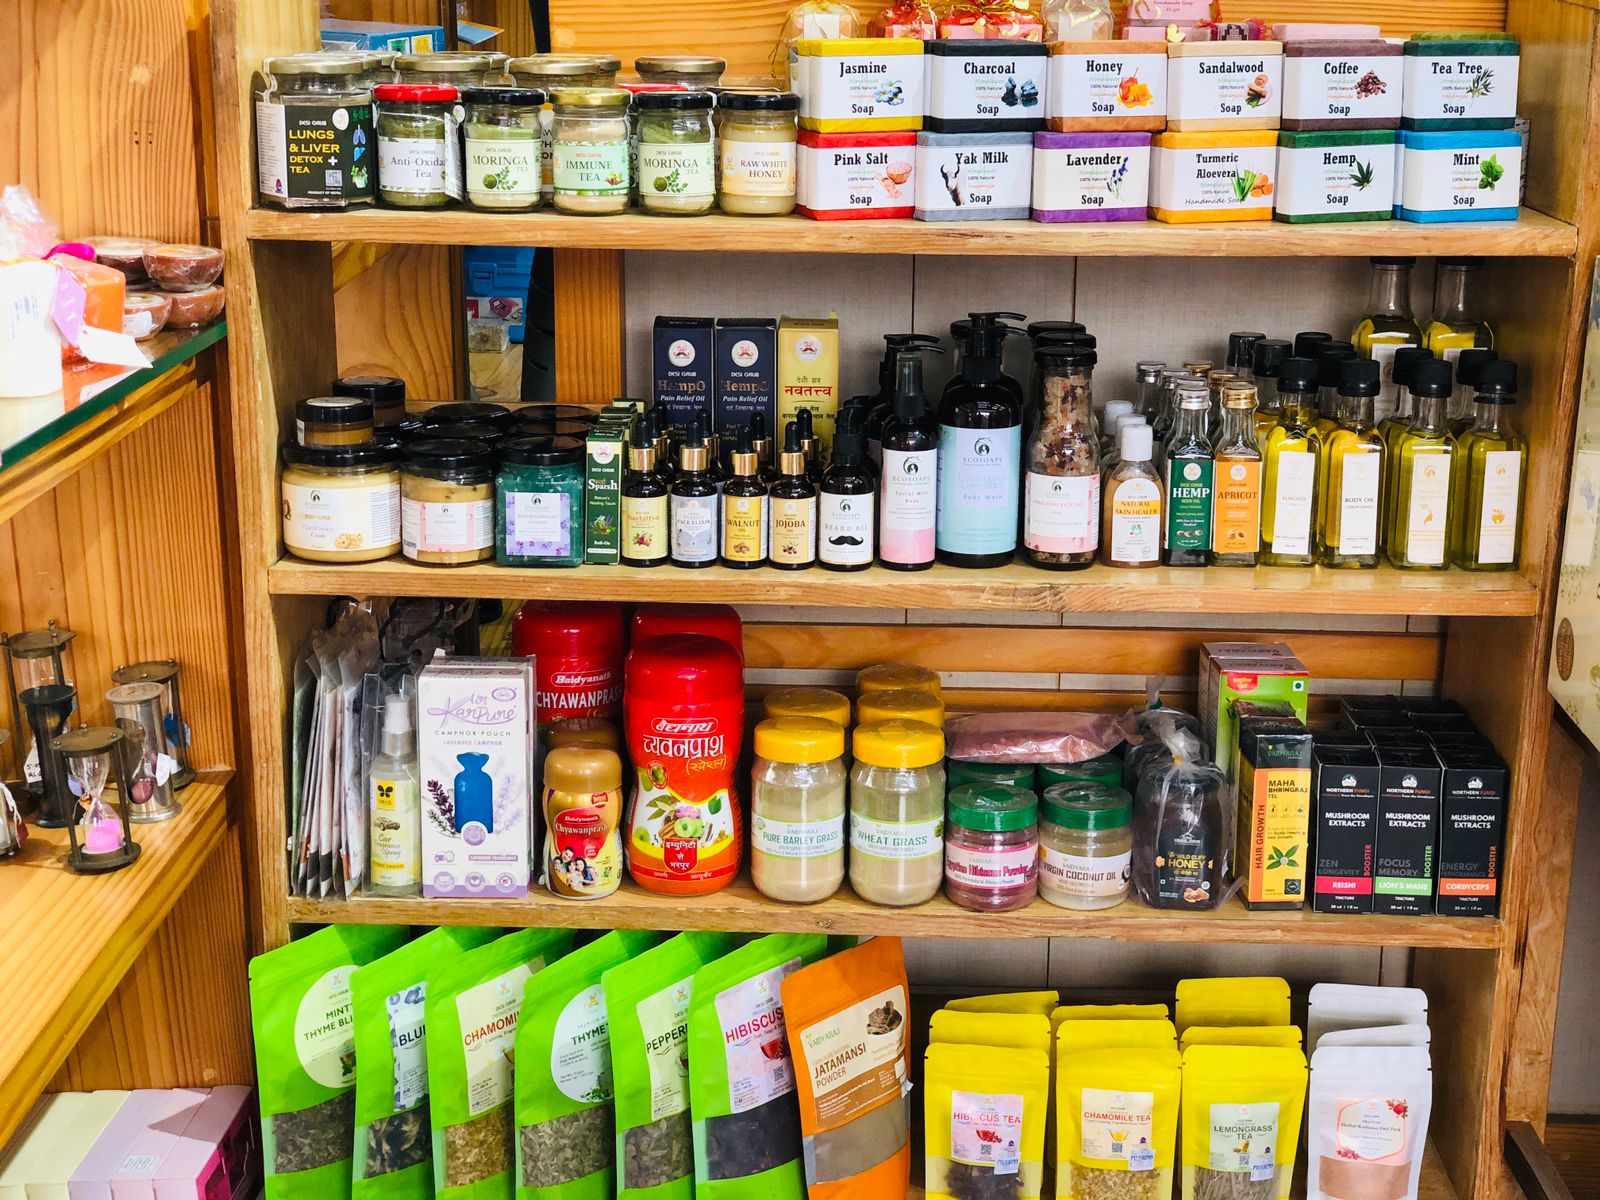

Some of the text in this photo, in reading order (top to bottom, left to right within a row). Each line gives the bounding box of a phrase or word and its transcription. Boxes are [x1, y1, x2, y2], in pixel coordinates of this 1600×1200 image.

[839, 61, 888, 77] Jasmine
[963, 61, 1015, 74] Charcoal
[1086, 60, 1123, 74] Honey
[1199, 61, 1264, 74] Sandalwood
[1324, 62, 1358, 74] Coffee
[1432, 62, 1483, 74] Tea Tree
[852, 104, 875, 115] Soap
[977, 104, 999, 116] Soap
[1092, 102, 1114, 114] Soap
[1220, 103, 1242, 114] Soap
[1328, 104, 1350, 115] Soap
[1443, 104, 1465, 115] Soap
[289, 130, 334, 140] LUNGS
[289, 144, 340, 153] & LIVER
[289, 156, 324, 164] DETOX
[472, 156, 528, 166] MORINGA
[643, 158, 699, 168] MORINGA
[740, 159, 789, 168] RAW WHITE
[834, 152, 888, 166] Pink Salt
[955, 152, 1009, 165] Yak Milk
[1066, 154, 1121, 166] Lavender
[1196, 153, 1239, 164] Turmeric
[1323, 153, 1357, 167] Hemp
[1453, 153, 1480, 165] Mint
[290, 166, 310, 174] TEA
[565, 161, 611, 170] IMMUNE
[415, 169, 431, 178] Tea
[579, 172, 601, 181] TEA
[749, 169, 783, 178] HONEY
[1196, 169, 1236, 179] Aloevera
[850, 195, 872, 206] Soap
[969, 193, 992, 205] Soap
[1081, 195, 1104, 206] Soap
[1185, 197, 1226, 205] Handmade
[1326, 194, 1349, 205] Soap
[1453, 195, 1475, 206] Soap
[588, 479, 618, 491] Sparsh
[1172, 487, 1210, 498] HEMP
[727, 519, 760, 527] WALNUT
[775, 519, 806, 528] JOJOBA
[555, 672, 612, 685] Baidyanath
[643, 734, 725, 759] च्यवनप्राश
[555, 822, 608, 834] Chyawanprash
[1389, 820, 1426, 828] EXTRACTS
[378, 834, 392, 843] Car
[763, 831, 840, 846] PURE BARLEY GRASS
[857, 831, 927, 847] WHEAT GRASS
[1255, 804, 1265, 869] HAIR GROWTH
[1168, 859, 1206, 869] HONEY
[1319, 860, 1338, 868] ZEN
[1364, 844, 1372, 877] BOOSTER
[1378, 858, 1411, 867] FOCUS
[1424, 845, 1432, 877] BOOSTER
[1487, 845, 1496, 878] BOOSTER
[1043, 861, 1117, 881] VIRGIN COCONUT OIL
[1378, 868, 1417, 876] MEMORY
[1441, 862, 1479, 871] ENERGY
[1406, 882, 1429, 890] MANE
[326, 1003, 353, 1020] MINT
[464, 1010, 520, 1046] CHAMOMI
[725, 1005, 784, 1043] HIBISCUS
[304, 1023, 336, 1041] THYME
[571, 1024, 606, 1045] THYME
[814, 1042, 866, 1079] JATAMANSI
[815, 1066, 847, 1089] POWDER
[953, 1111, 1021, 1124] HIBISCUS TEA
[1084, 1111, 1134, 1121] CHAMOMILE
[1214, 1125, 1273, 1133] LEMONGRASS
